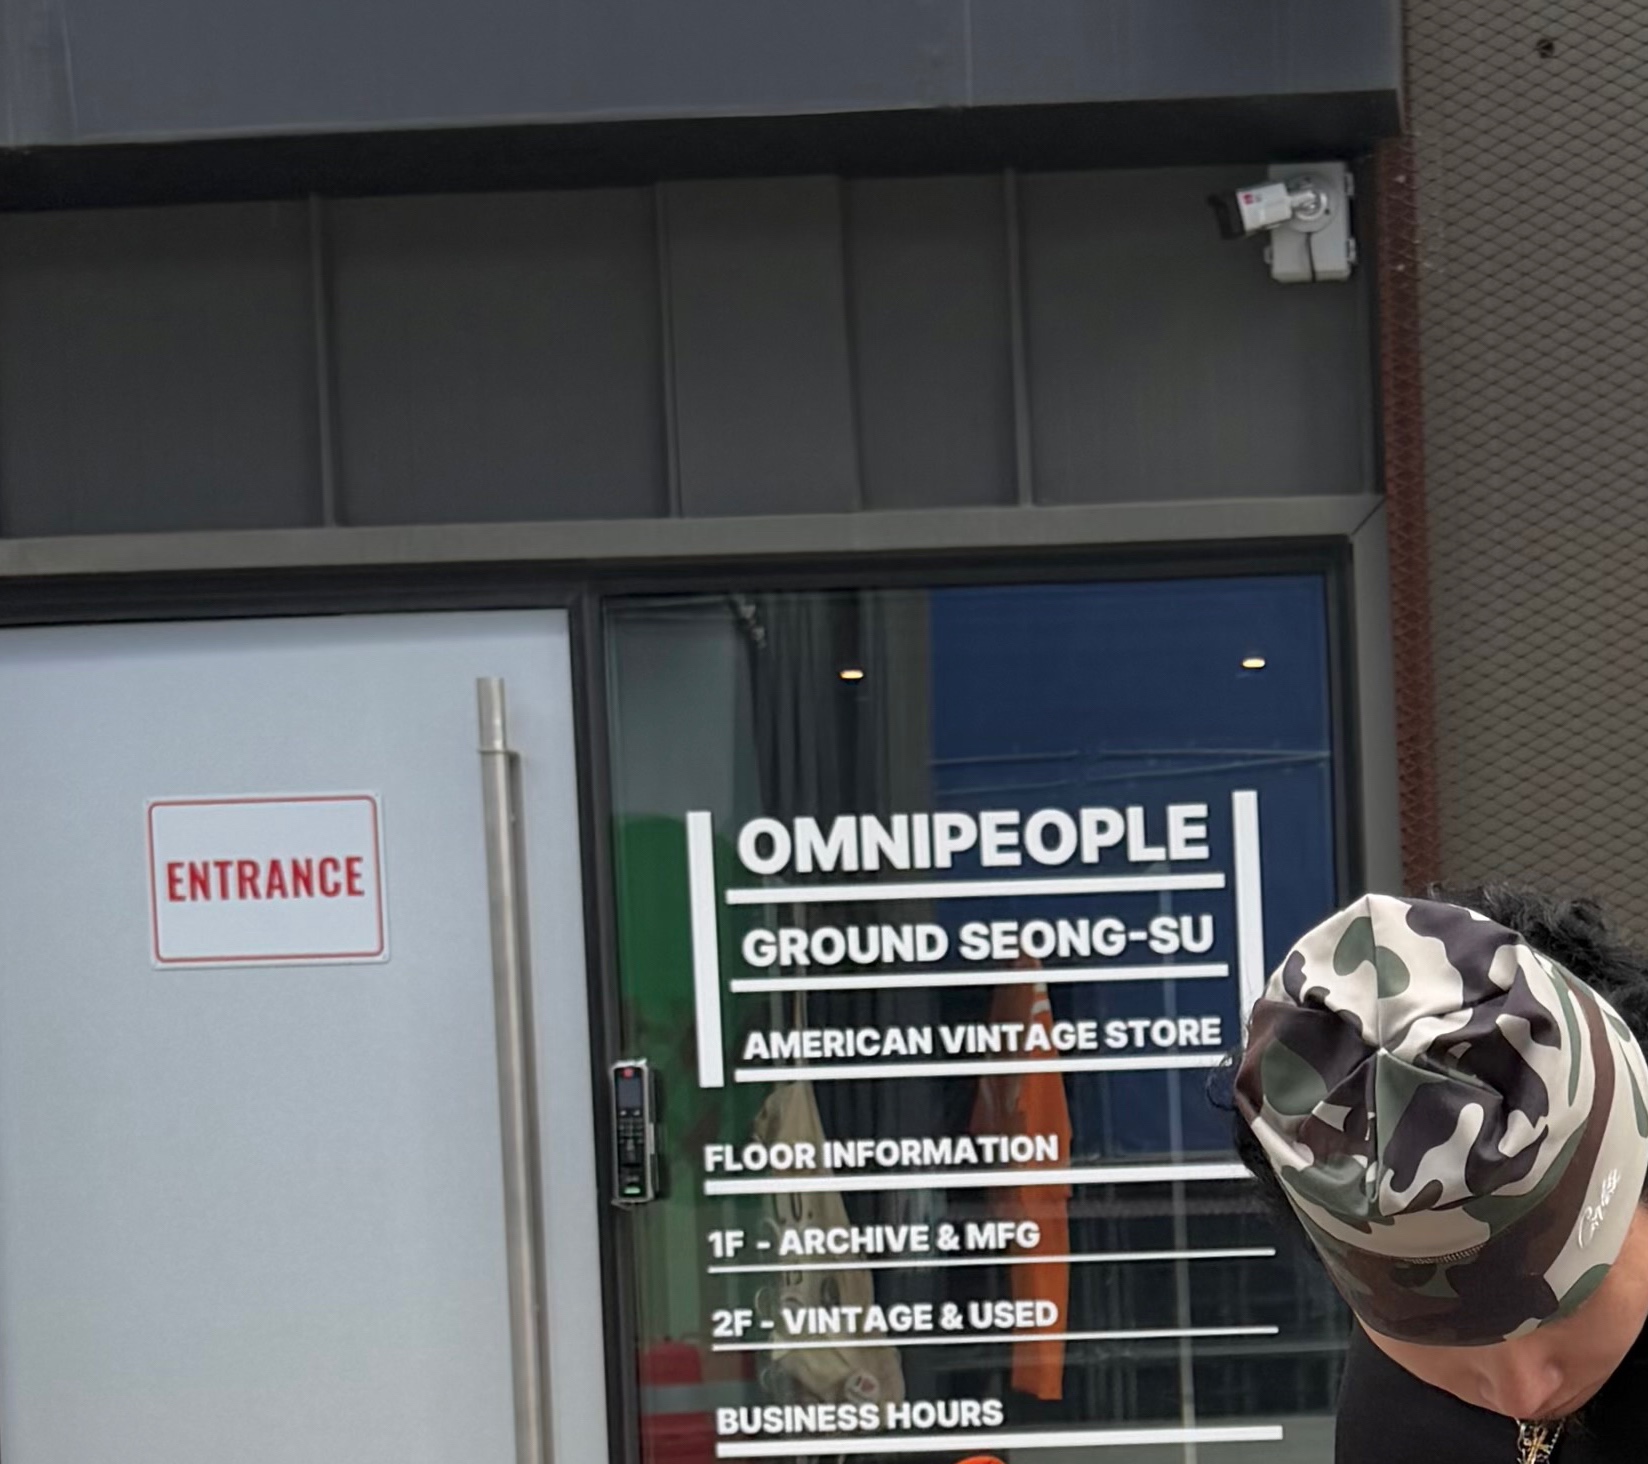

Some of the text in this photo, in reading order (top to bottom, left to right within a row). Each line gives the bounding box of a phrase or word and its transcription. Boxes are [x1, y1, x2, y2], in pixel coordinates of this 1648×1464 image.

[737, 803, 1210, 875] OMNIPEOPLE
[166, 855, 365, 903] ENTRANCE
[742, 914, 1214, 967] GROUND SEONG-SU
[743, 1017, 1222, 1061] AMERICAN VINTAGE STORE
[704, 1134, 1059, 1172] FLOOR INFORMATION
[708, 1229, 744, 1259] 1F
[778, 1225, 929, 1257] ARCHIVE
[937, 1223, 960, 1252] &
[966, 1221, 1041, 1249] MFG
[712, 1308, 753, 1337] 2F
[781, 1304, 934, 1335] VINTAGE
[940, 1302, 965, 1330] &
[968, 1300, 1059, 1328] USED
[716, 1399, 1004, 1436] BUSINESS HOURS
